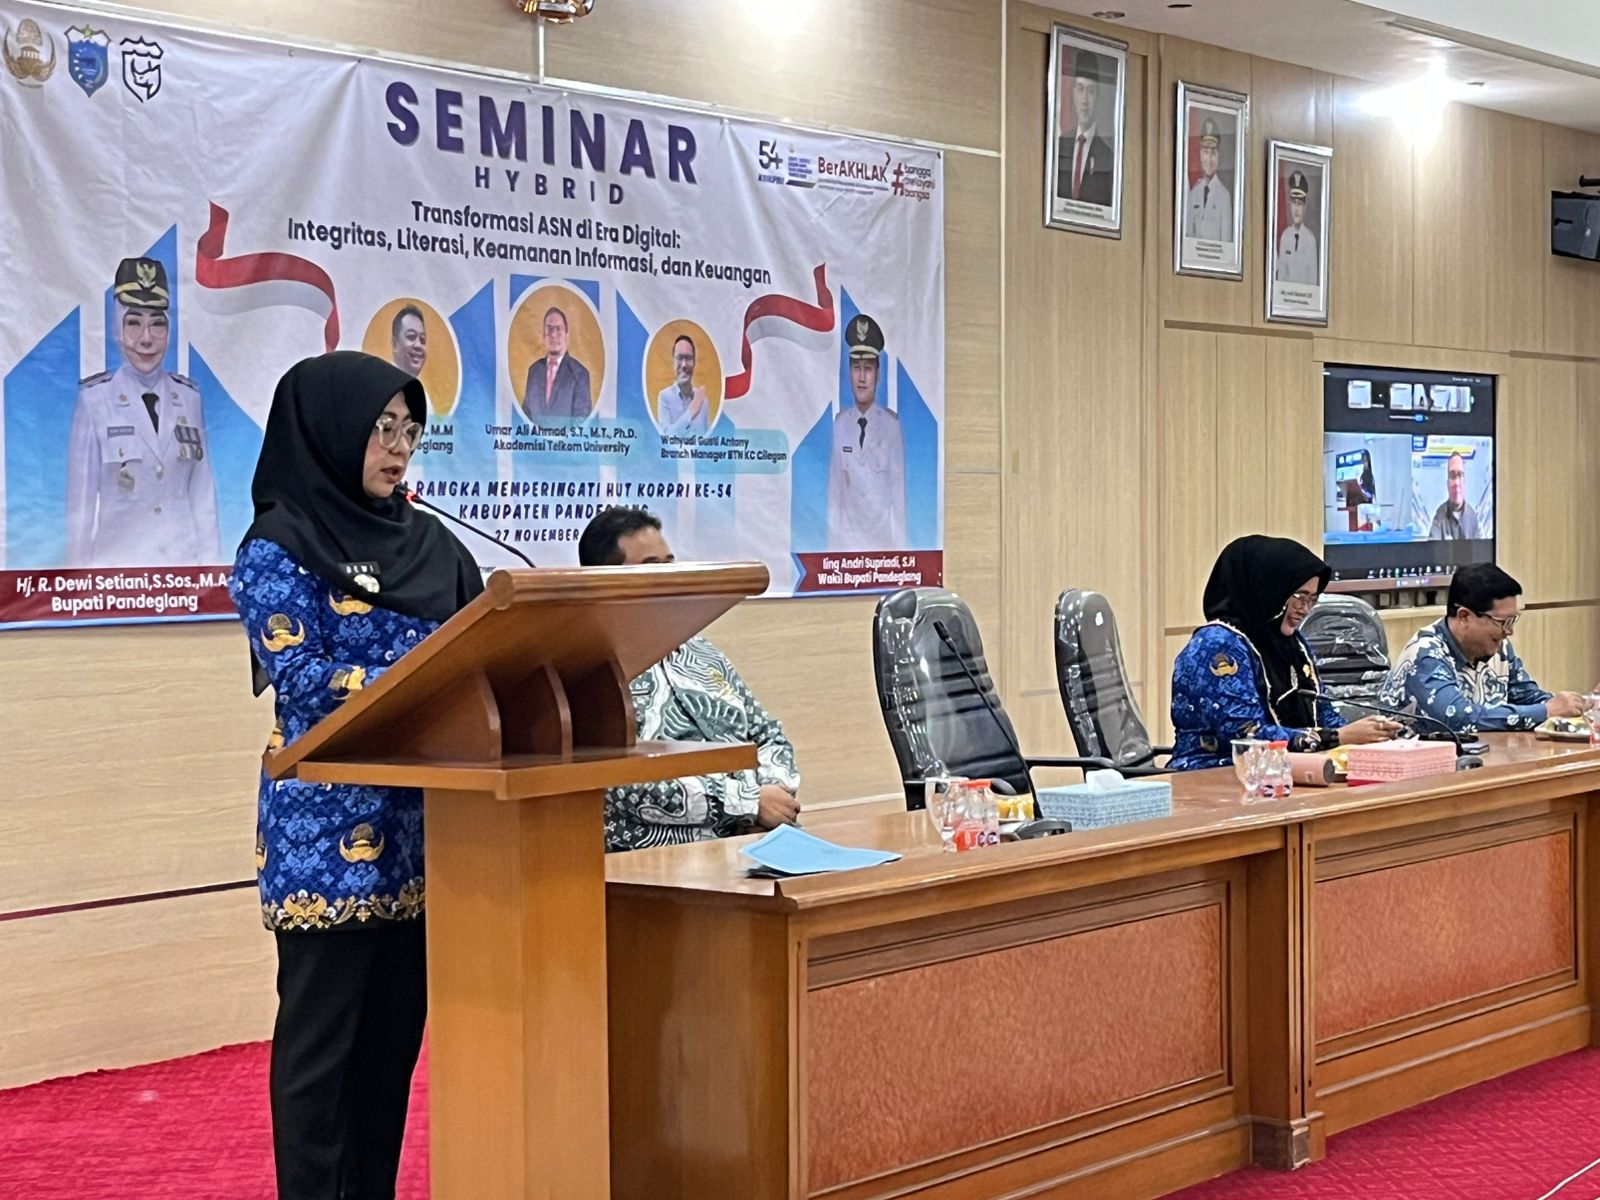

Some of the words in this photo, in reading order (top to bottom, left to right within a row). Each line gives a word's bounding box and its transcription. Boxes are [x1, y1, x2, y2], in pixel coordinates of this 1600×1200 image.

[385, 82, 698, 185] SEMINAR
[818, 156, 889, 184] BerAKHLAK
[475, 165, 624, 205] HYBRID
[411, 200, 534, 234] Transformasi
[538, 215, 571, 237] ASN
[576, 219, 593, 239] di
[596, 223, 619, 243] Era
[623, 224, 681, 253] Digital:
[287, 218, 392, 251] Integritas,
[397, 227, 470, 259] Literasi,
[473, 236, 571, 265] Keamanan
[575, 247, 658, 277] Informasi,
[661, 256, 692, 277] dan
[695, 260, 771, 288] Keuangan
[485, 424, 512, 436] Umar
[515, 424, 529, 436] Ali
[531, 425, 568, 438] Ahmad,
[417, 439, 453, 454] eglang
[493, 438, 546, 451] Akademisi
[547, 440, 583, 452] Telkom
[584, 441, 630, 457] University
[661, 448, 689, 459] Branch
[690, 449, 726, 462] Manager
[745, 450, 756, 460] KC
[416, 480, 480, 497] RANGKA
[487, 481, 600, 498] MEMPERINGATI
[606, 483, 632, 497] HUT
[637, 483, 690, 498] KORPRI
[695, 483, 732, 498] KE-54
[459, 504, 549, 520] KABUPATEN
[514, 529, 579, 542] NOVEMBER
[841, 556, 864, 569] Andri
[902, 556, 916, 568] S.H
[16, 577, 35, 598] Hj.
[38, 577, 52, 592] R.
[55, 574, 92, 592] Dewi
[817, 572, 843, 584] Wakil
[844, 571, 871, 587] Bupati
[873, 571, 921, 586] Pandeglang
[51, 594, 103, 616] Bupati
[107, 593, 198, 613] Pandeglang
